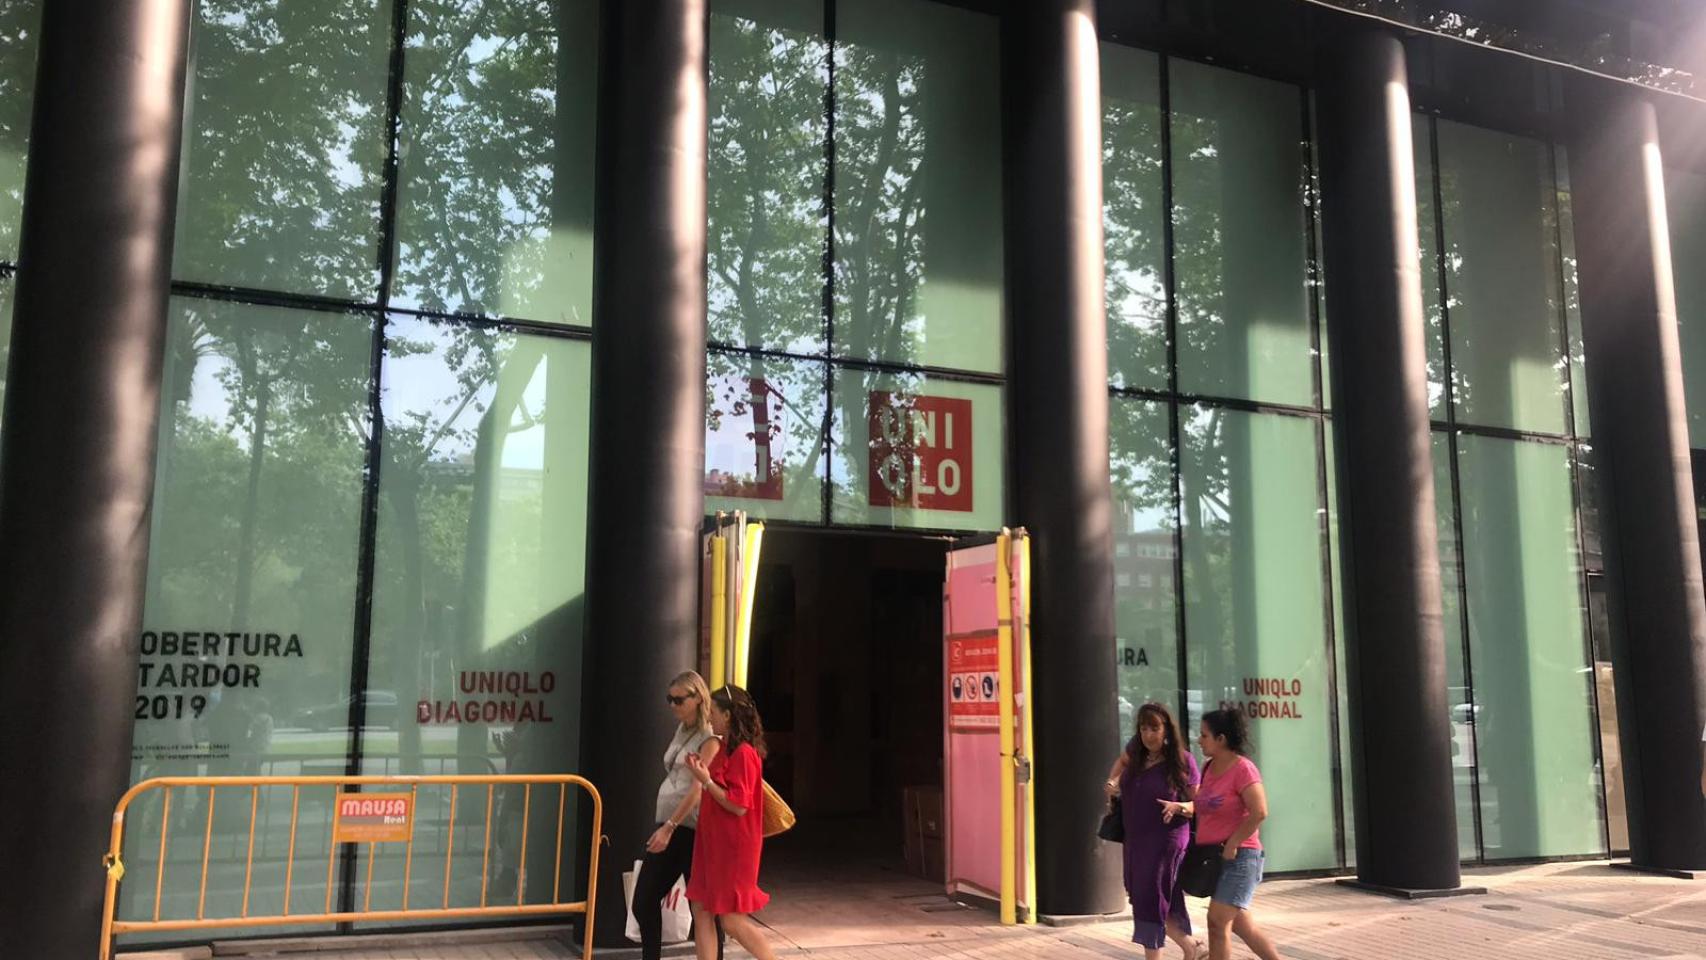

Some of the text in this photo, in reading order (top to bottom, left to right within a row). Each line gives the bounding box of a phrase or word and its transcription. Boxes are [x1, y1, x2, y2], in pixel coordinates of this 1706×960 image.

[140, 631, 304, 657] OBERTURA
[138, 663, 261, 688] TARDOR
[461, 671, 555, 697] UNIQLO
[1243, 678, 1302, 698] UNIQLO
[135, 695, 207, 720] 2019
[417, 700, 553, 723] DIAGONAL
[342, 799, 405, 816] MAUSA
